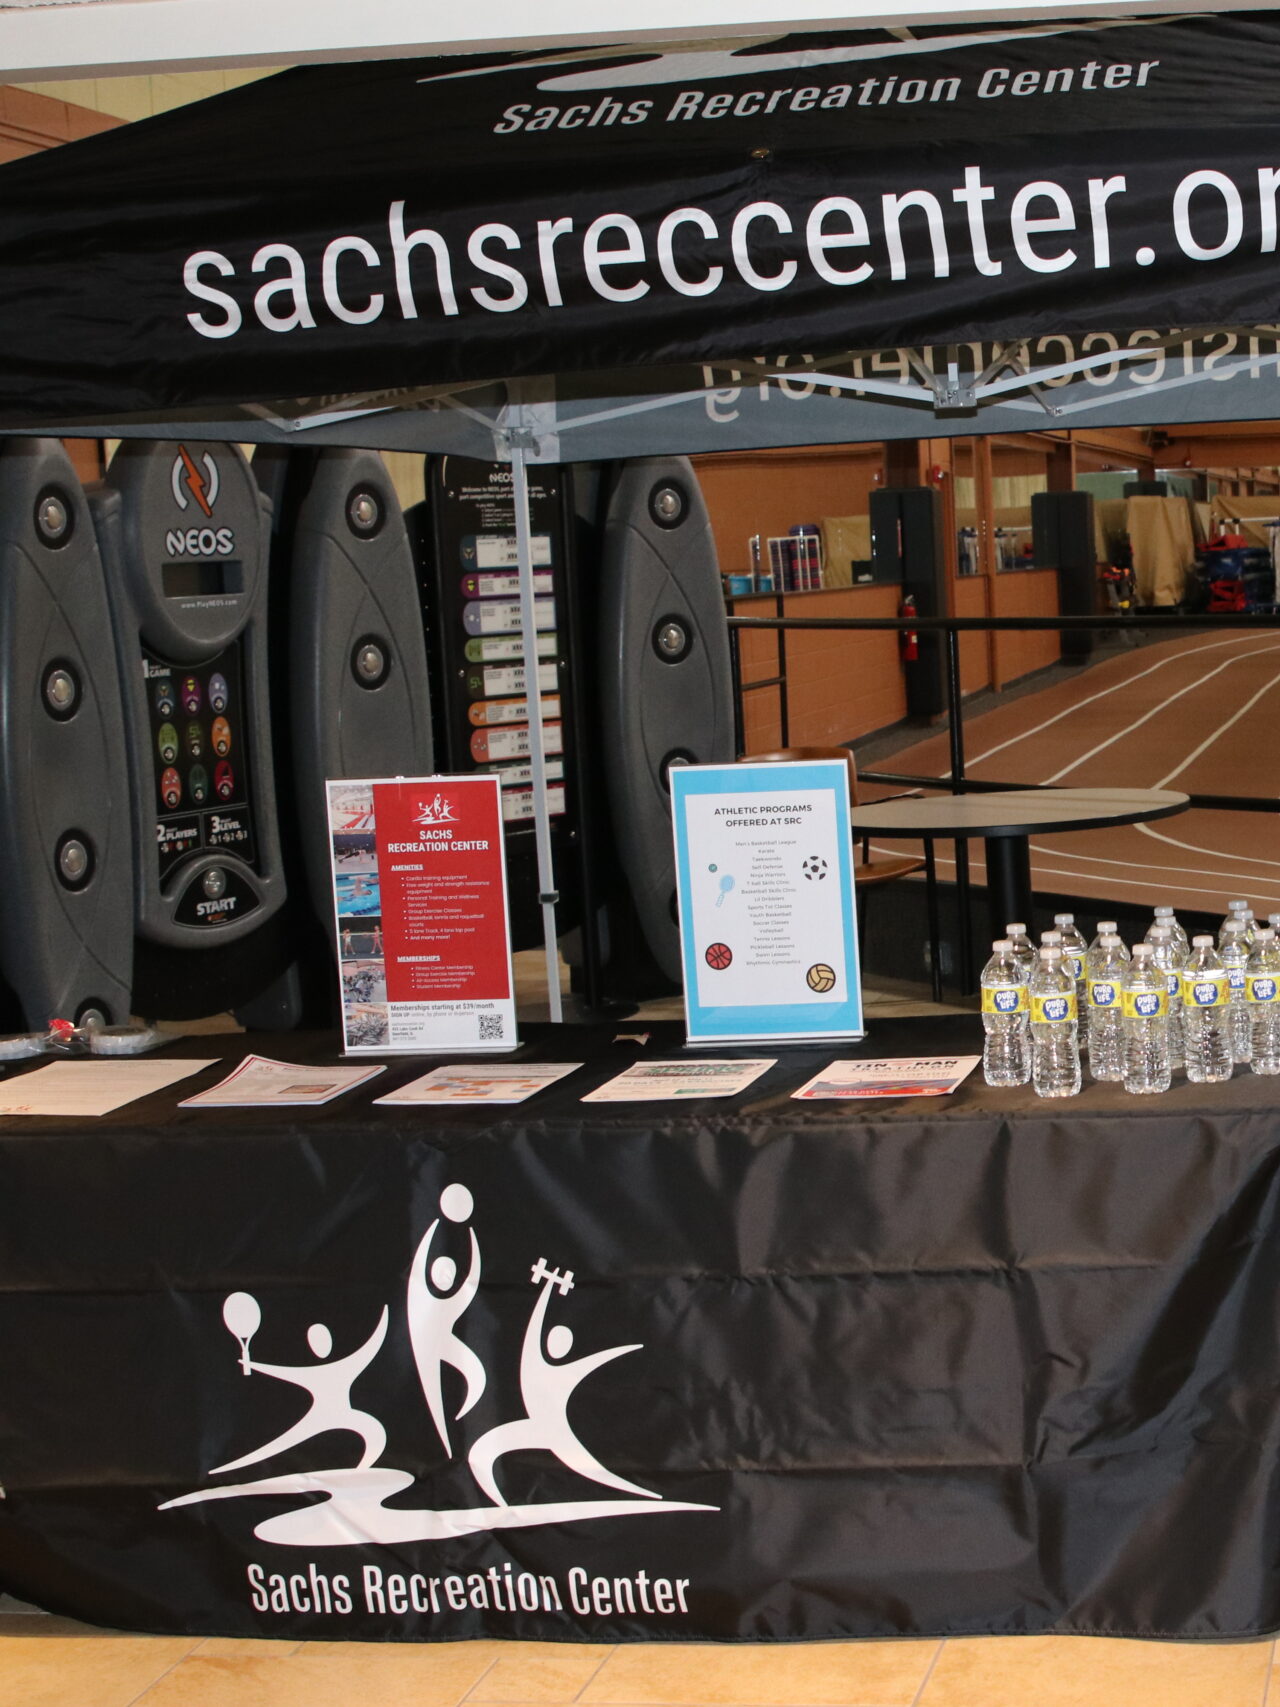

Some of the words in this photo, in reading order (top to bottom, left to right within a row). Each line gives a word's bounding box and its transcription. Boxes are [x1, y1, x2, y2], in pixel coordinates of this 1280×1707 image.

[493, 97, 653, 134] Sachs
[667, 76, 961, 121] Recreation
[977, 60, 1160, 99] Center
[165, 527, 235, 556] NEOS
[181, 599, 238, 609] www.PlayNEOS.com
[142, 659, 149, 679] 1
[149, 668, 171, 678] GAME
[714, 806, 758, 815] ATHLETIC
[760, 804, 812, 813] PROGRAMS
[211, 816, 220, 833] 3
[220, 821, 241, 831] LEVEL
[725, 818, 768, 827] OFFERED
[770, 818, 782, 826] AT
[784, 817, 802, 825] SRC
[156, 824, 166, 842] 2
[166, 828, 198, 840] PLAYERS
[419, 829, 453, 840] SACHS
[388, 841, 449, 853] RECREATION
[450, 840, 489, 851] CENTER
[391, 864, 424, 872] AMENITIES
[196, 897, 236, 916] START
[397, 955, 440, 963] MEMBERSHIPS
[390, 1004, 430, 1013] Memberships
[432, 1003, 454, 1011] starting
[247, 1563, 351, 1614] Sachs
[362, 1562, 563, 1614] Recreation
[567, 1566, 690, 1615] Center
